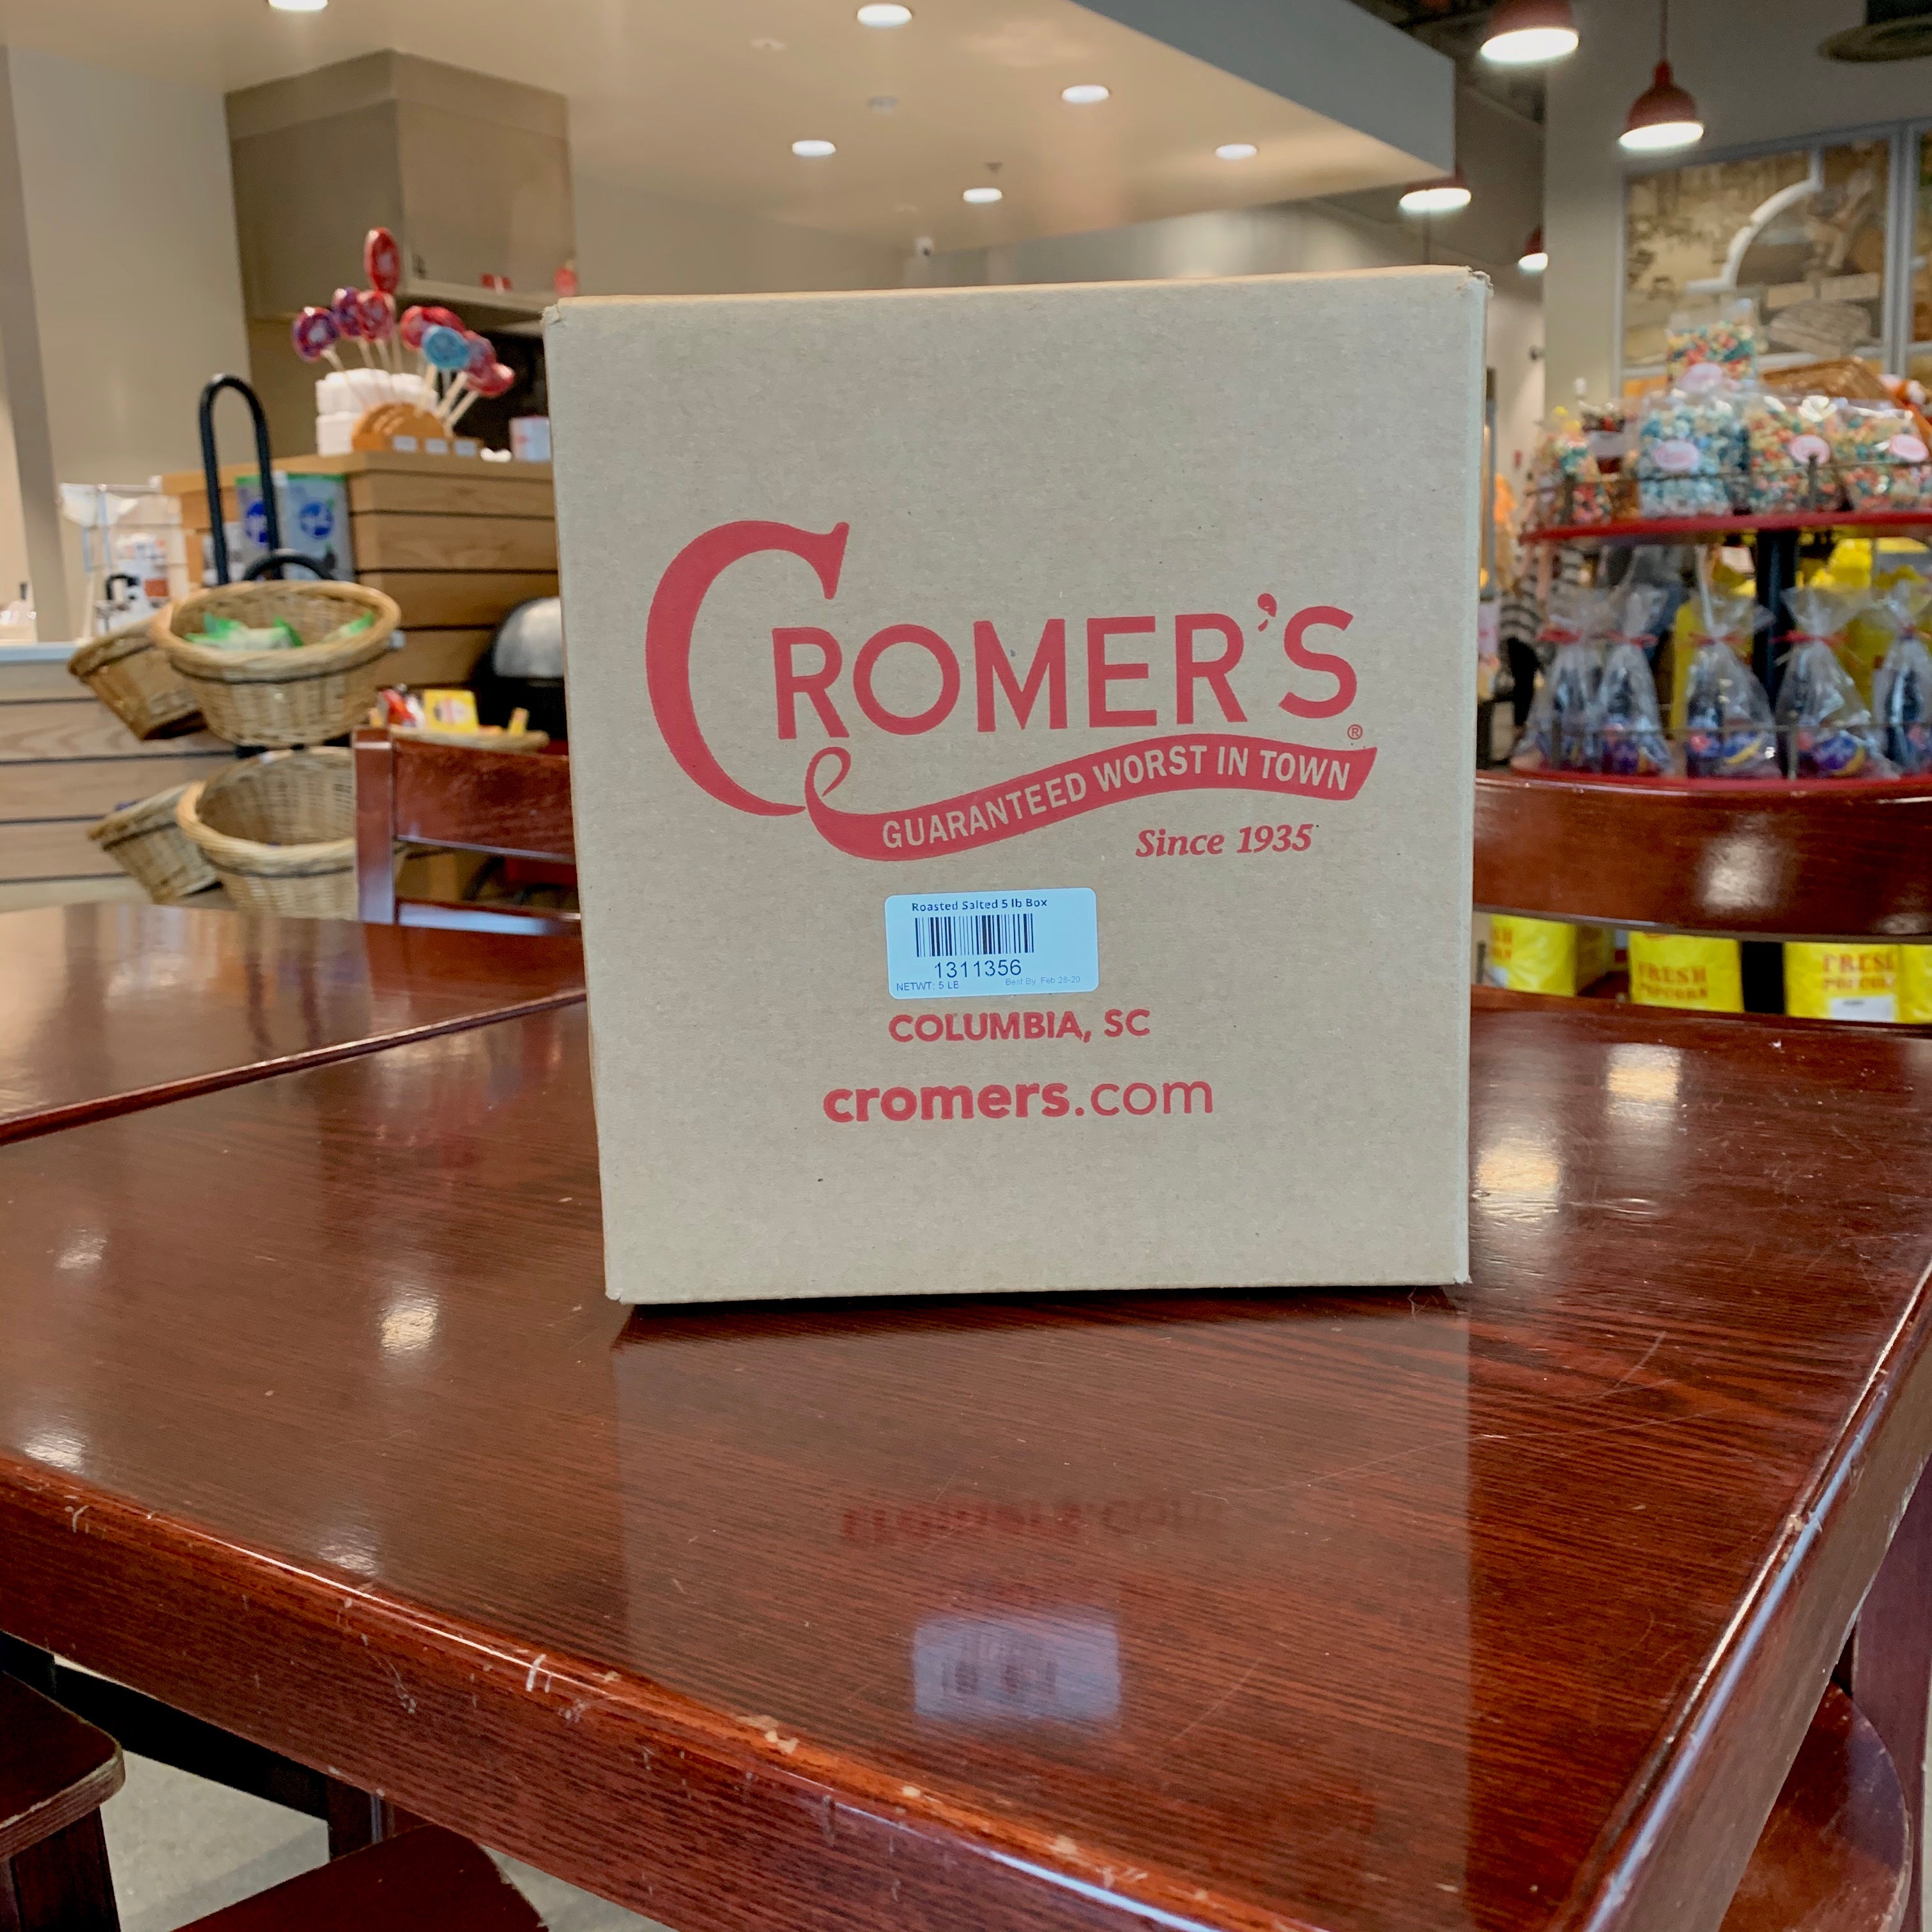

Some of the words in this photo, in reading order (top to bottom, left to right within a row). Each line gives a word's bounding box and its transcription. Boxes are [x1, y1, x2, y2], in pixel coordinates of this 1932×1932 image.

[646, 520, 1359, 816] CROMER'S
[882, 772, 1087, 850] GUARANTEED
[1092, 745, 1208, 792] WORST
[1216, 746, 1249, 777] IN
[1260, 749, 1351, 792] TOWN
[1135, 829, 1225, 859] Since
[1236, 824, 1314, 854] 1935
[911, 901, 958, 912] Roasted
[962, 900, 999, 910] Salted
[1001, 900, 1008, 908] 5
[1011, 898, 1022, 907] lb
[1025, 898, 1048, 907] Box
[934, 959, 1022, 978] 1311356
[938, 981, 944, 990] 5
[1005, 977, 1023, 986] Best
[1025, 977, 1036, 986] By
[1058, 976, 1081, 984] 28-20
[888, 1011, 1091, 1043] COLUMBIA,
[1104, 1009, 1151, 1037] SC
[823, 1080, 1213, 1123] cromers.com
